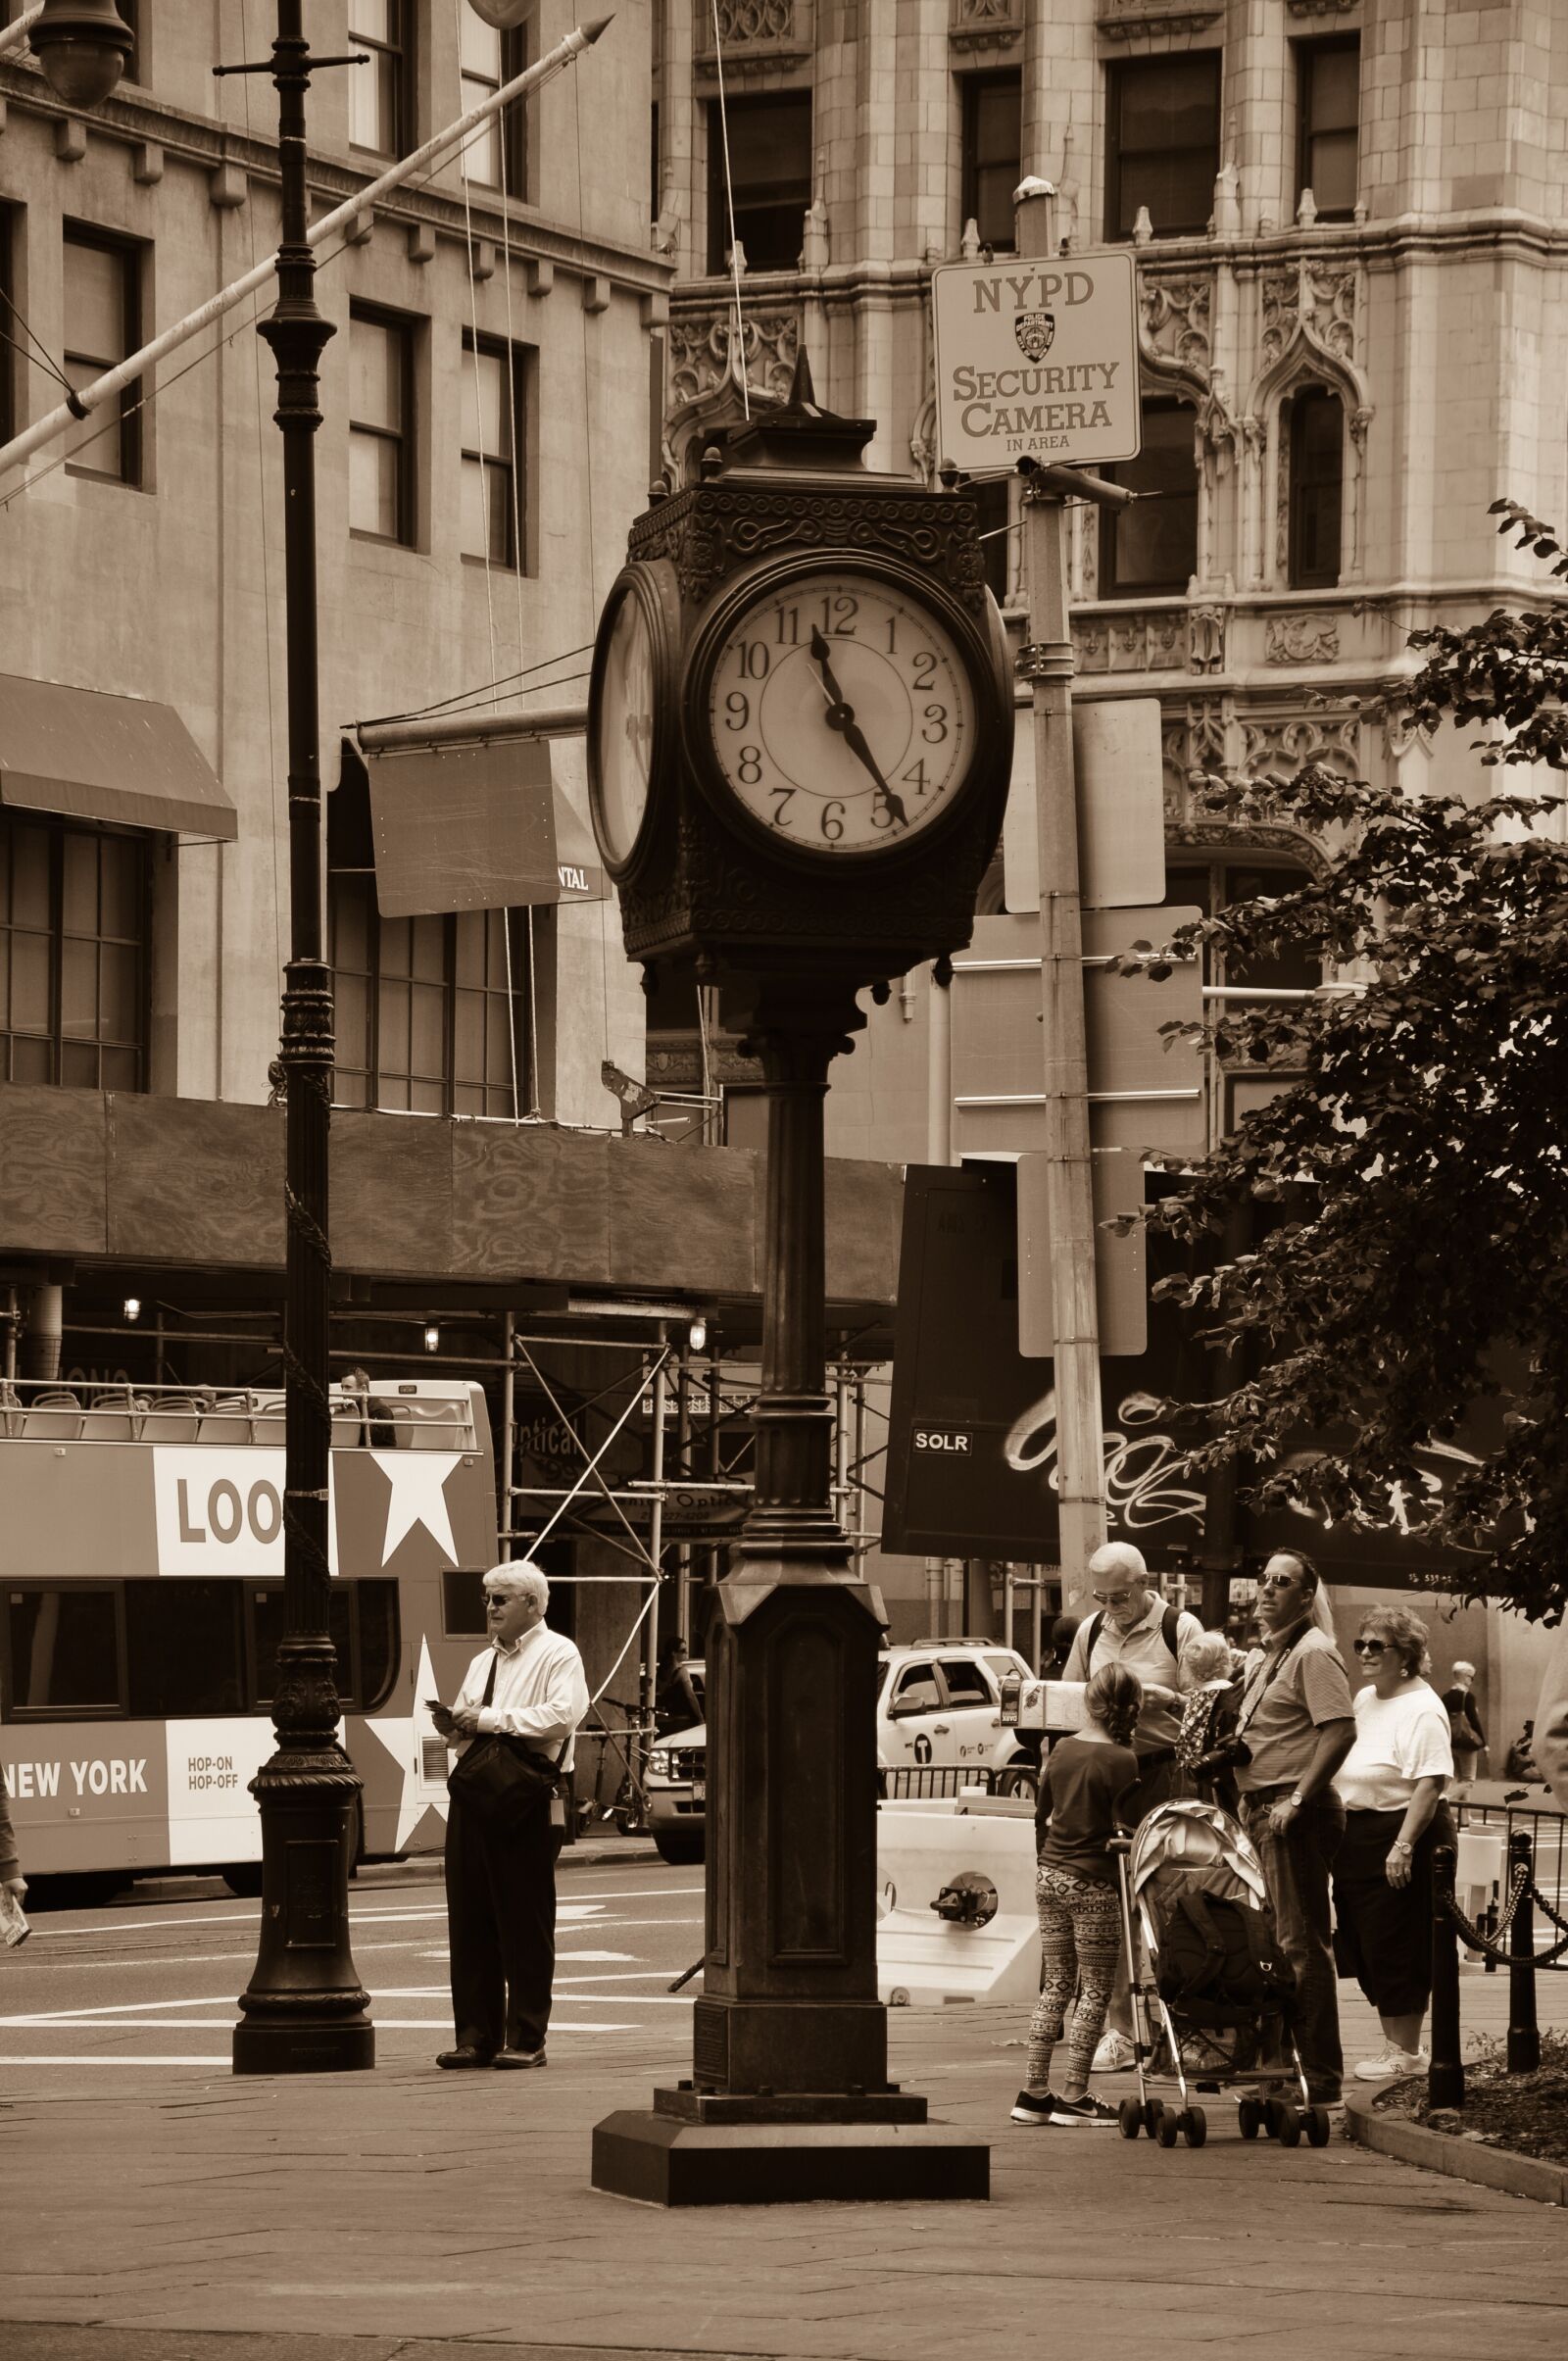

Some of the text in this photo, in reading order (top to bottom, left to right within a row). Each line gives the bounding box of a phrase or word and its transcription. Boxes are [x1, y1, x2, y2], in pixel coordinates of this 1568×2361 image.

[972, 271, 1095, 314] NYPD
[953, 362, 1120, 402] SECURITY
[960, 401, 1112, 438] CAMERA
[1006, 435, 1070, 452] IN AREA
[775, 607, 801, 646] 11
[821, 596, 858, 636] 12
[885, 615, 899, 655] 1
[737, 639, 770, 680] 10
[912, 652, 938, 691] 2
[725, 692, 750, 731] 9
[921, 704, 949, 744] 3
[738, 746, 762, 784] 8
[901, 758, 930, 796] 4
[768, 787, 798, 826] 7
[820, 802, 846, 841] 6
[915, 1432, 968, 1451] SOLR
[2, 1758, 148, 1798] NEW YORK
[188, 1755, 233, 1772] HOP-ON
[188, 1774, 238, 1790] HOP-OFF
